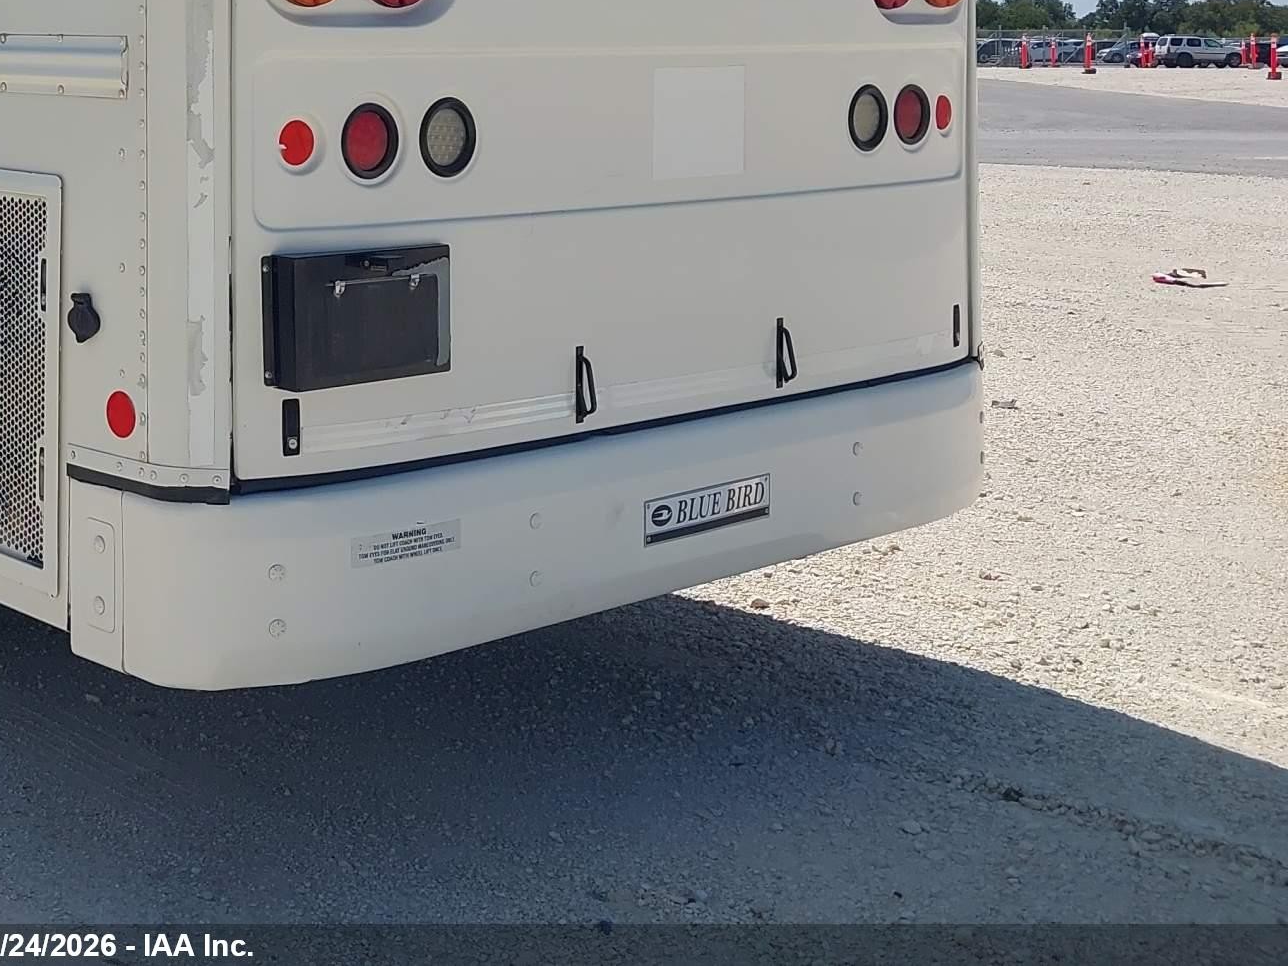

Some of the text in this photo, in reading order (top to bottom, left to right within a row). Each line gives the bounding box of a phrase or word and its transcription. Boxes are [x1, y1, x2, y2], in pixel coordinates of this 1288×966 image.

[676, 482, 764, 524] BLUE BIRD
[392, 528, 427, 540] WARNING
